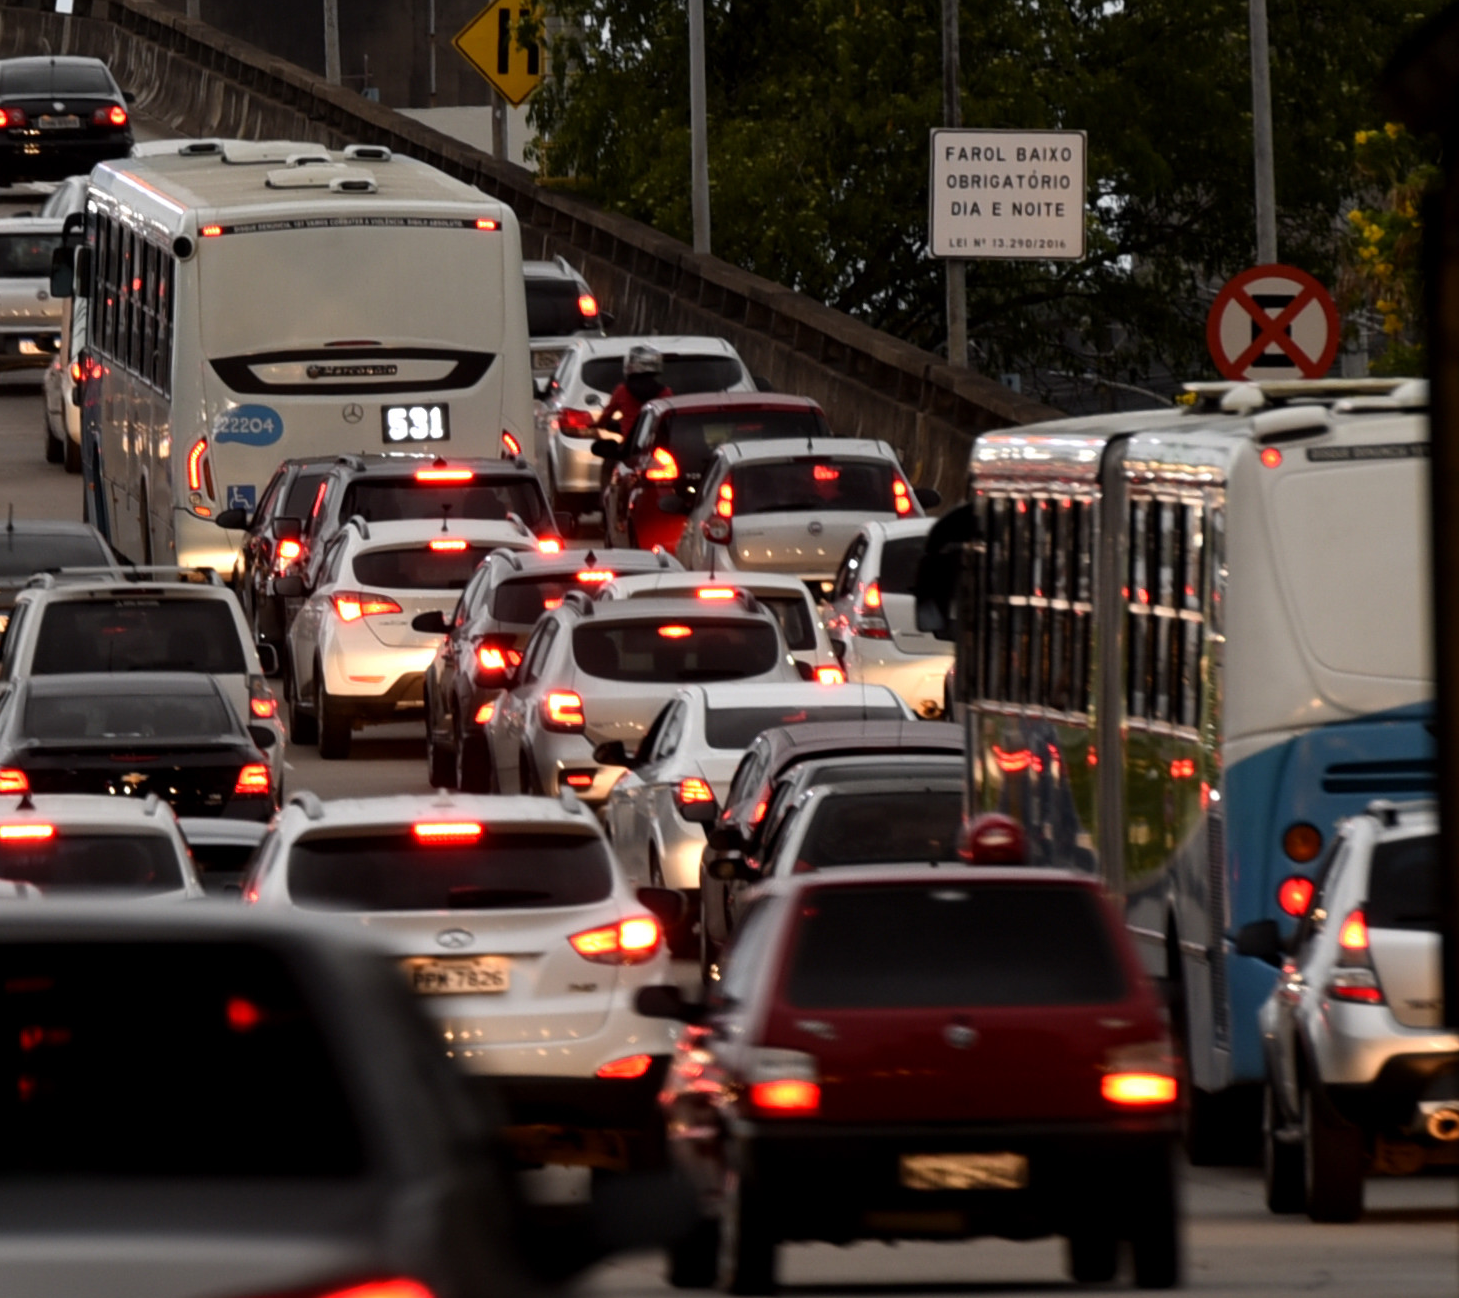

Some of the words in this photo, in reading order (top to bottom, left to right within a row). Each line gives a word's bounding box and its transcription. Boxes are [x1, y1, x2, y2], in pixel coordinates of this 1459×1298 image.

[945, 146, 1006, 162] FAROL
[1016, 146, 1072, 162] BAIXO
[946, 169, 1071, 189] OBRIGATÓRIO
[950, 201, 982, 217] DIA
[992, 202, 1002, 217] E
[1012, 202, 1065, 217] NOITE
[949, 238, 967, 248] LEI
[992, 238, 1067, 249] 13.290/2016
[386, 406, 444, 441] 531
